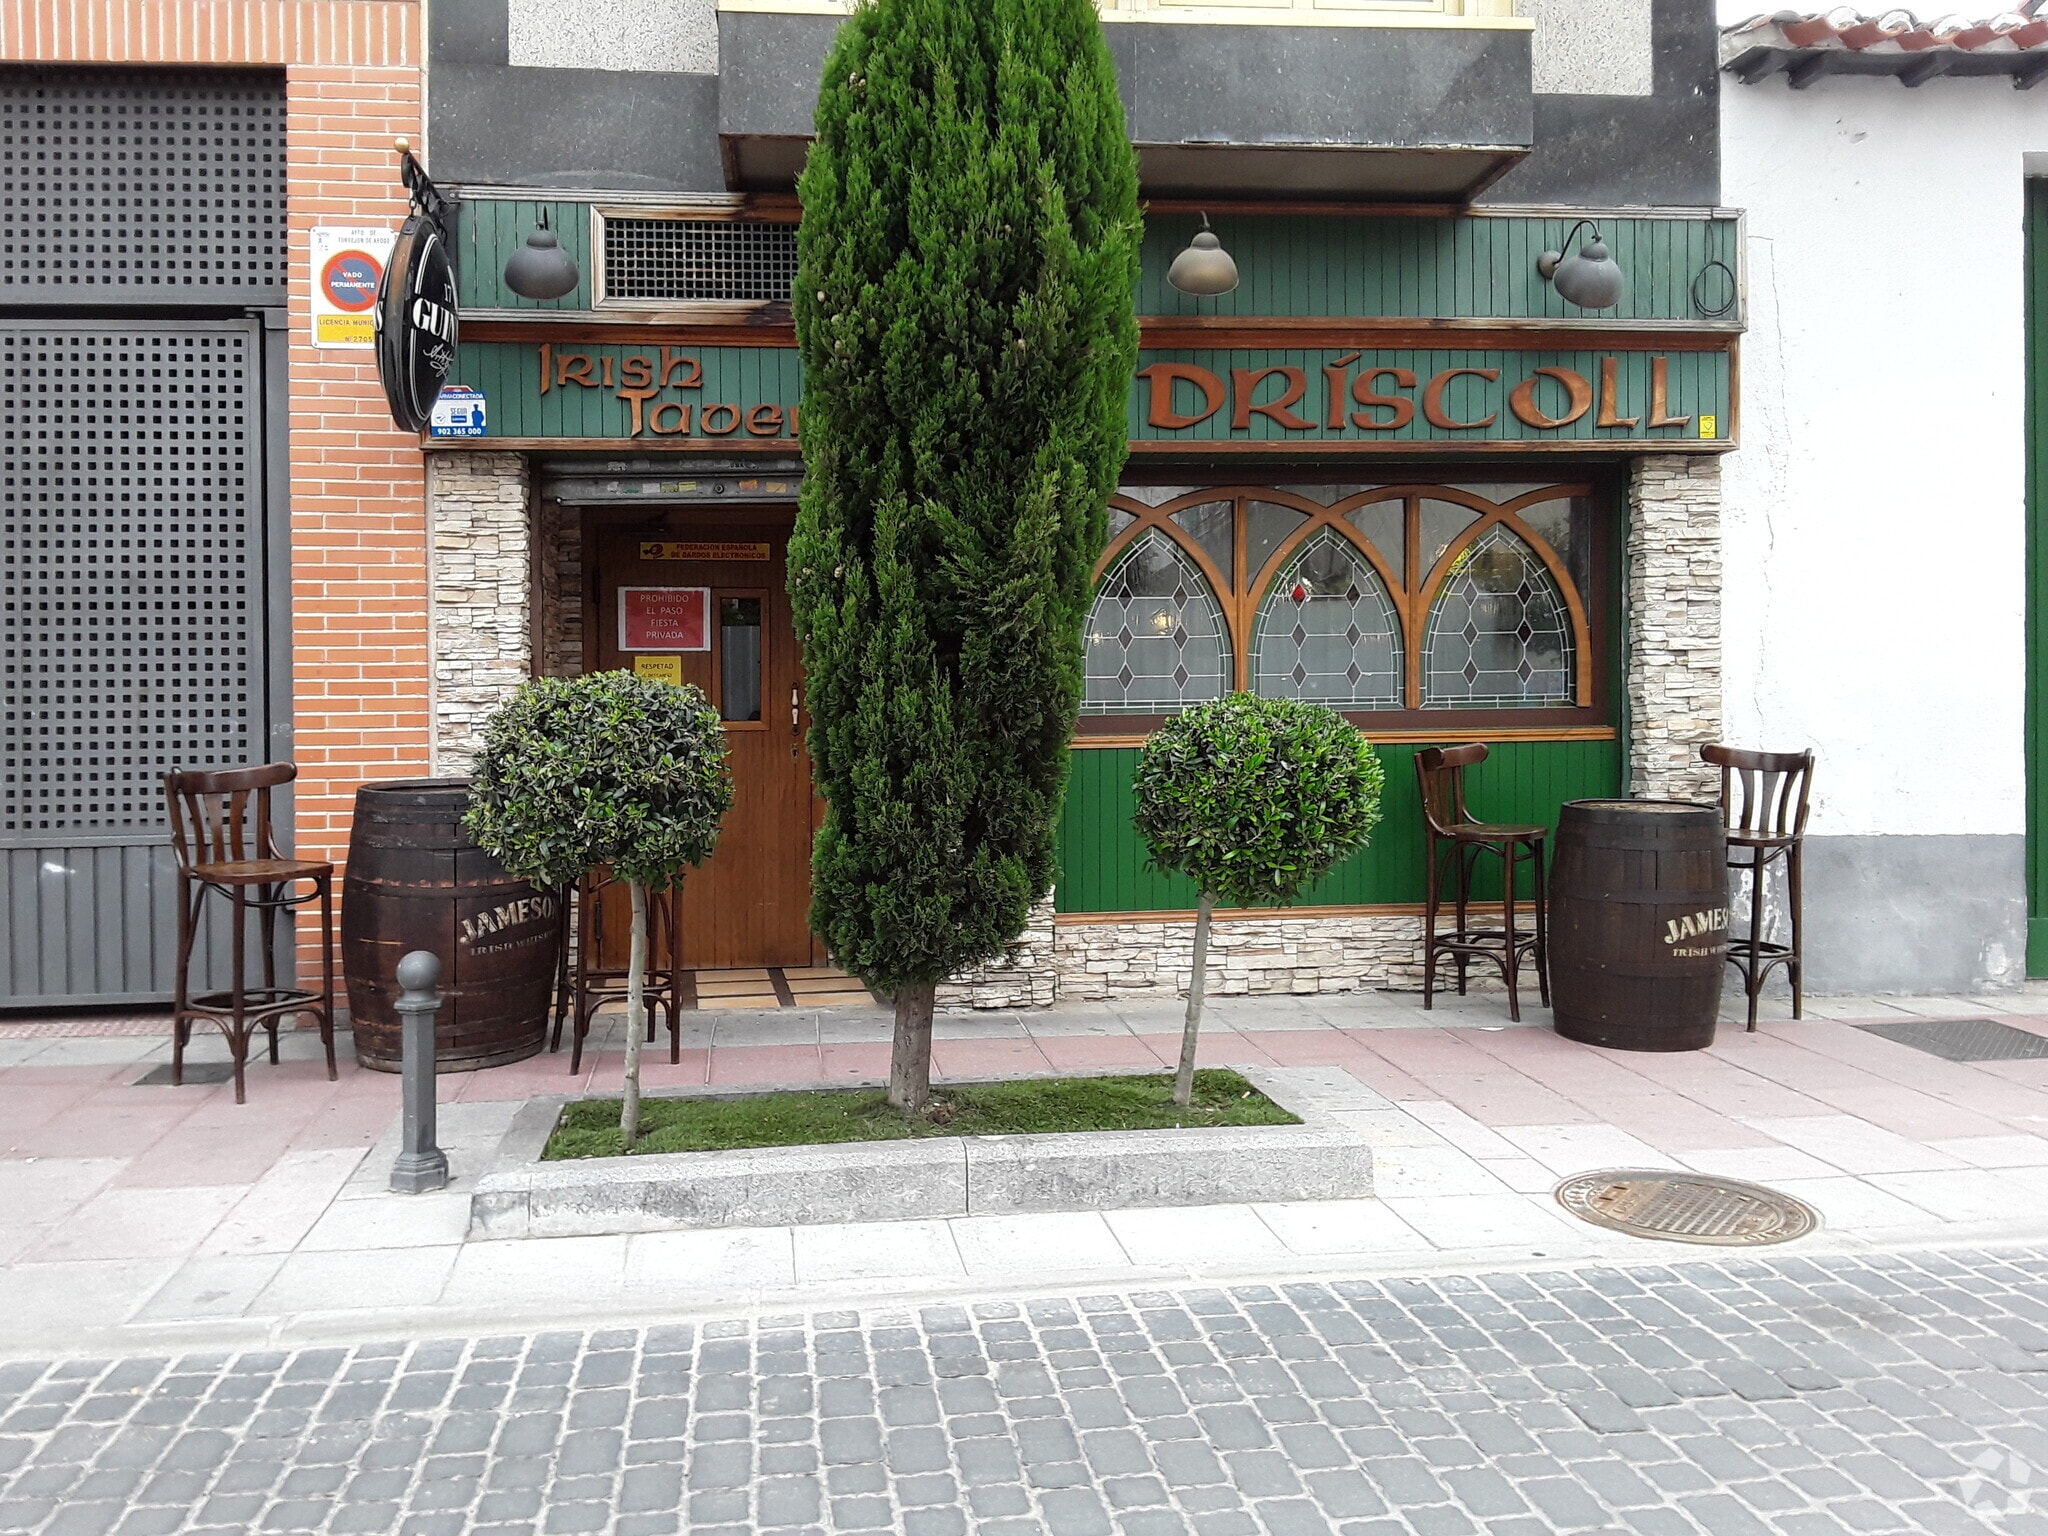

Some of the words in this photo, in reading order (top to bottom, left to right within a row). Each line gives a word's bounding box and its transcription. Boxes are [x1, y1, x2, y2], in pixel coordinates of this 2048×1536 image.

[330, 281, 375, 289] PERMANENTE
[1136, 352, 1693, 431] DRÍSCOLL
[437, 427, 451, 435] 902
[452, 427, 466, 435] 365
[467, 427, 482, 435] 000
[670, 551, 680, 559] DE
[640, 594, 689, 603] PROHIBIDO
[646, 607, 656, 615] EL
[660, 607, 683, 615] PASO
[650, 619, 678, 627] FIESTA
[645, 631, 684, 639] PRIVADA
[1672, 948, 1708, 957] IRISH
